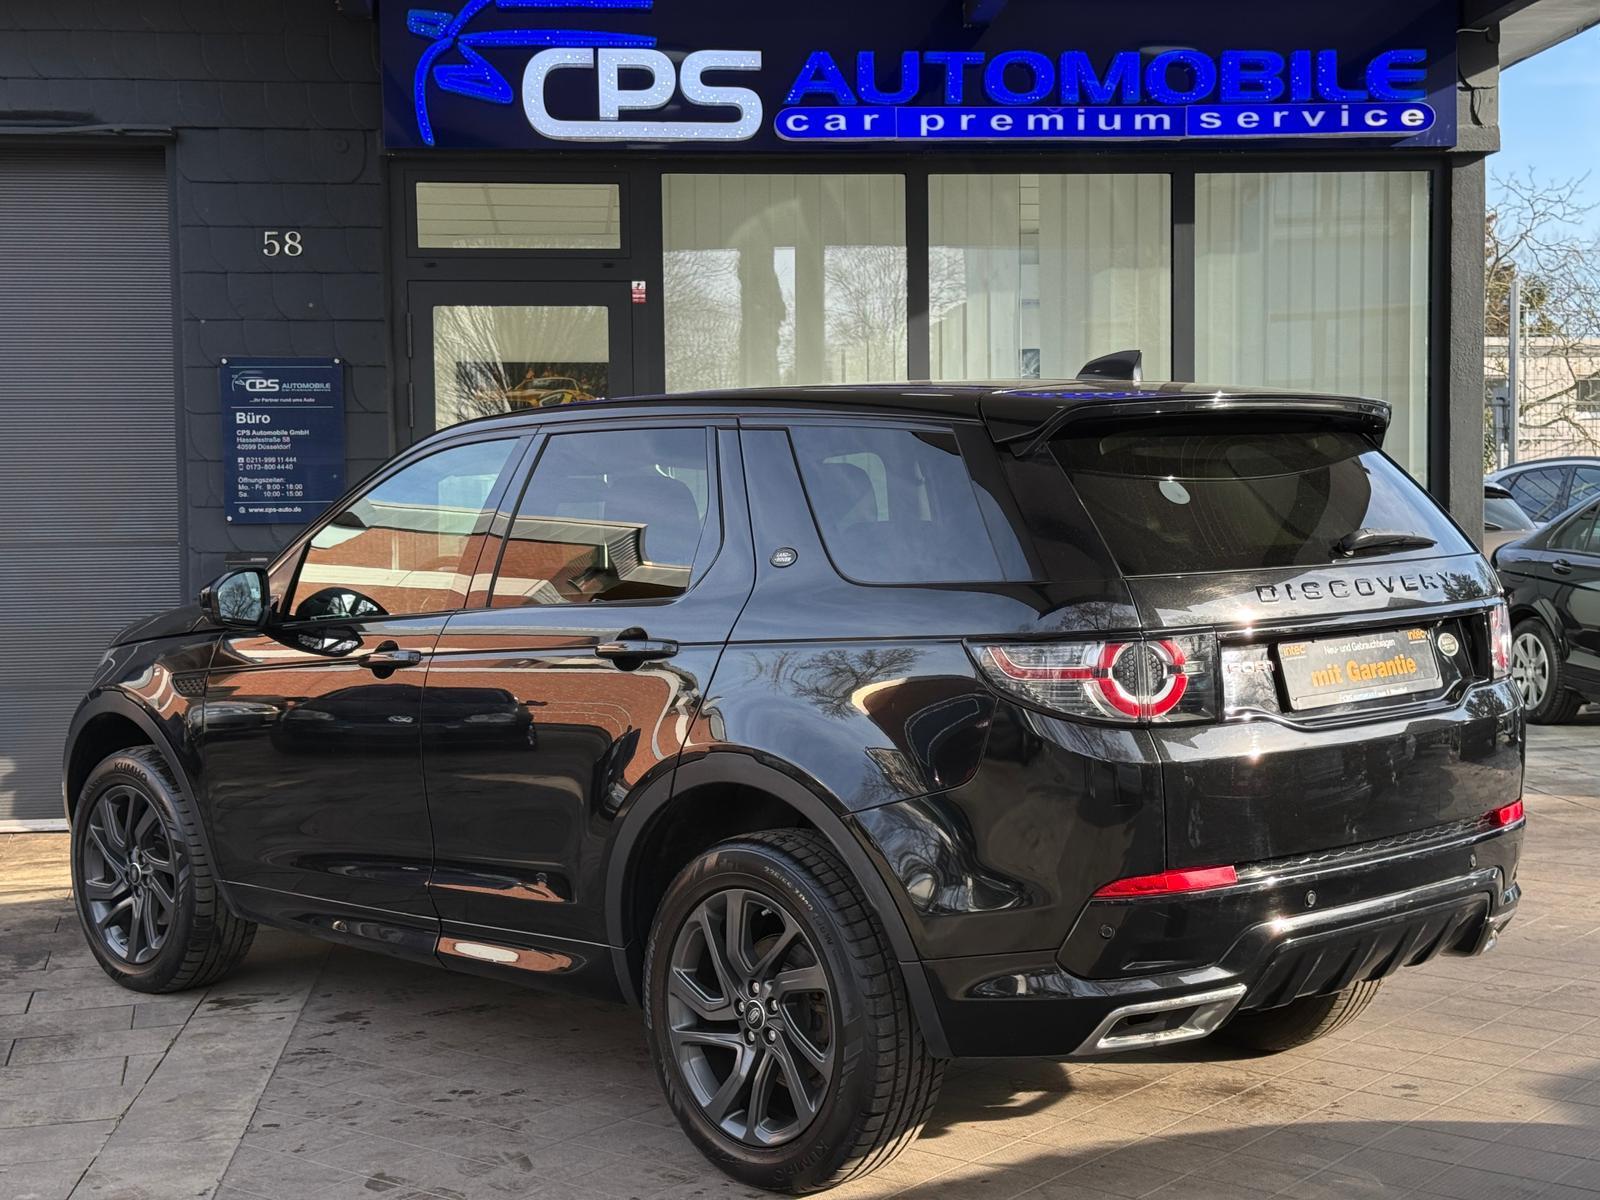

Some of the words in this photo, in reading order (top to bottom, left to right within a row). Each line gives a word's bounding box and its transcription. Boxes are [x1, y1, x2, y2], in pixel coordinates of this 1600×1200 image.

[522, 48, 763, 141] CPS
[783, 48, 1428, 106] AUTOMOBILE
[786, 111, 880, 132] car
[920, 109, 1171, 136] premium
[1200, 105, 1426, 129] service
[263, 231, 303, 257] 58
[245, 379, 280, 392] CPS
[281, 382, 331, 390] AUTOMOBILE
[235, 412, 271, 424] Büro
[1255, 571, 1454, 603] DISCOVERY
[1311, 664, 1344, 687] mit
[1346, 654, 1417, 682] Garantie
